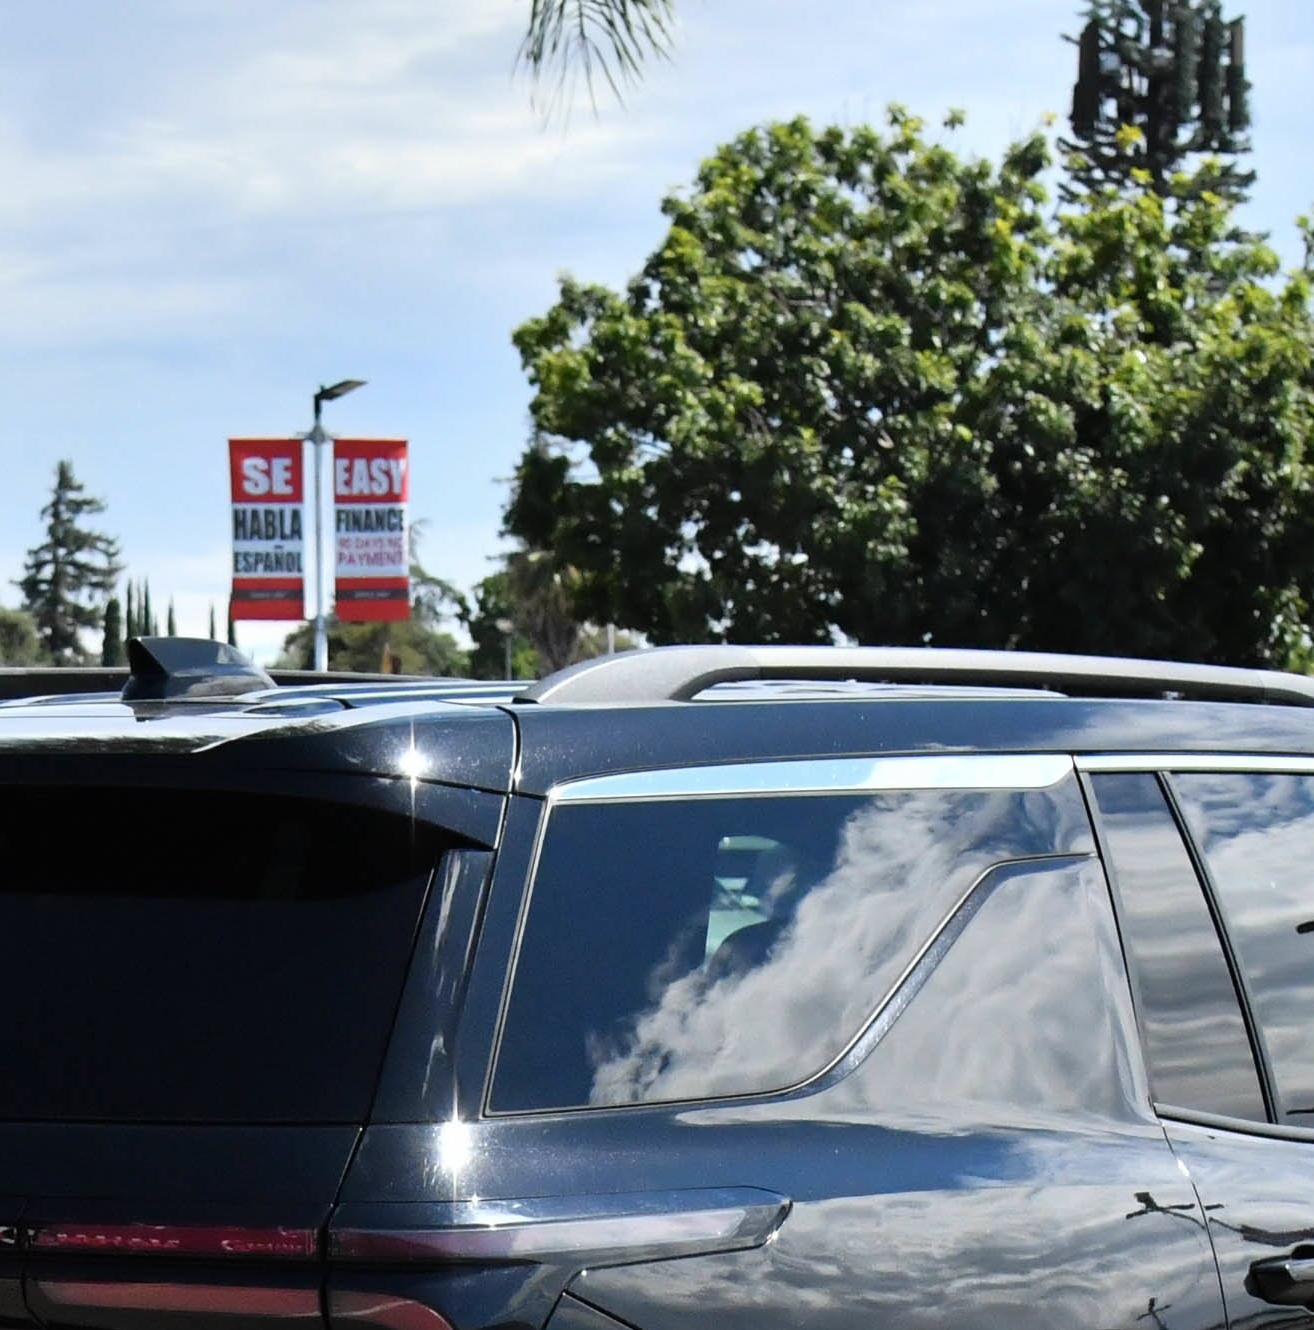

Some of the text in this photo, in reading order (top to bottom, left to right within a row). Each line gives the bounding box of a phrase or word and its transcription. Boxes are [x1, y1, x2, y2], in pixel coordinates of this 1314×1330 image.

[241, 457, 293, 496] SE
[336, 457, 407, 496] EASY
[234, 508, 302, 541] HABLA
[336, 508, 404, 532] FINANCE
[234, 544, 303, 573] ESPAÑOL
